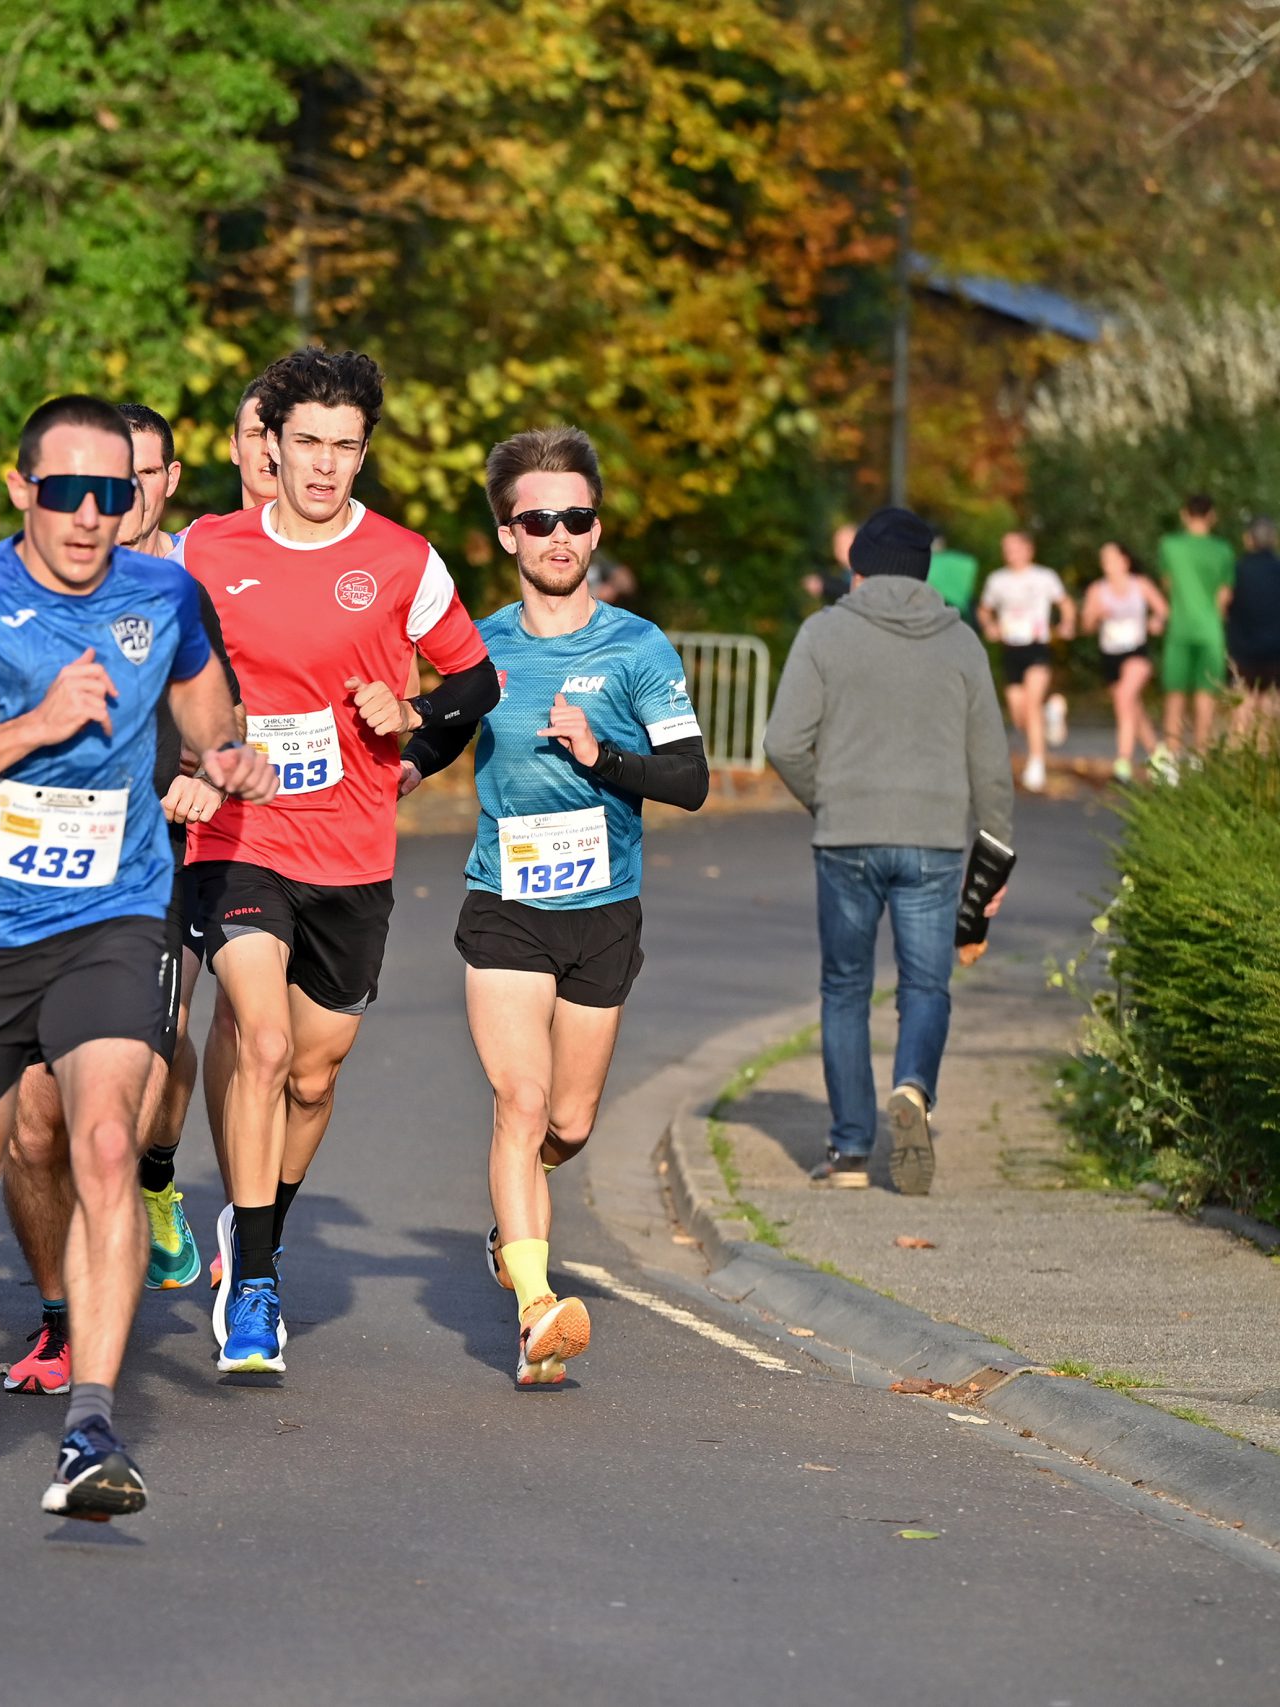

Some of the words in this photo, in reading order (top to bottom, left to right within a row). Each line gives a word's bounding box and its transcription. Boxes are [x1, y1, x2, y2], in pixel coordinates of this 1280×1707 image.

[340, 591, 373, 601] STAPS
[307, 737, 331, 749] RUN
[577, 836, 600, 847] RUN
[9, 845, 96, 879] 433
[517, 857, 596, 894] 1327
[224, 907, 261, 919] ATORKA
